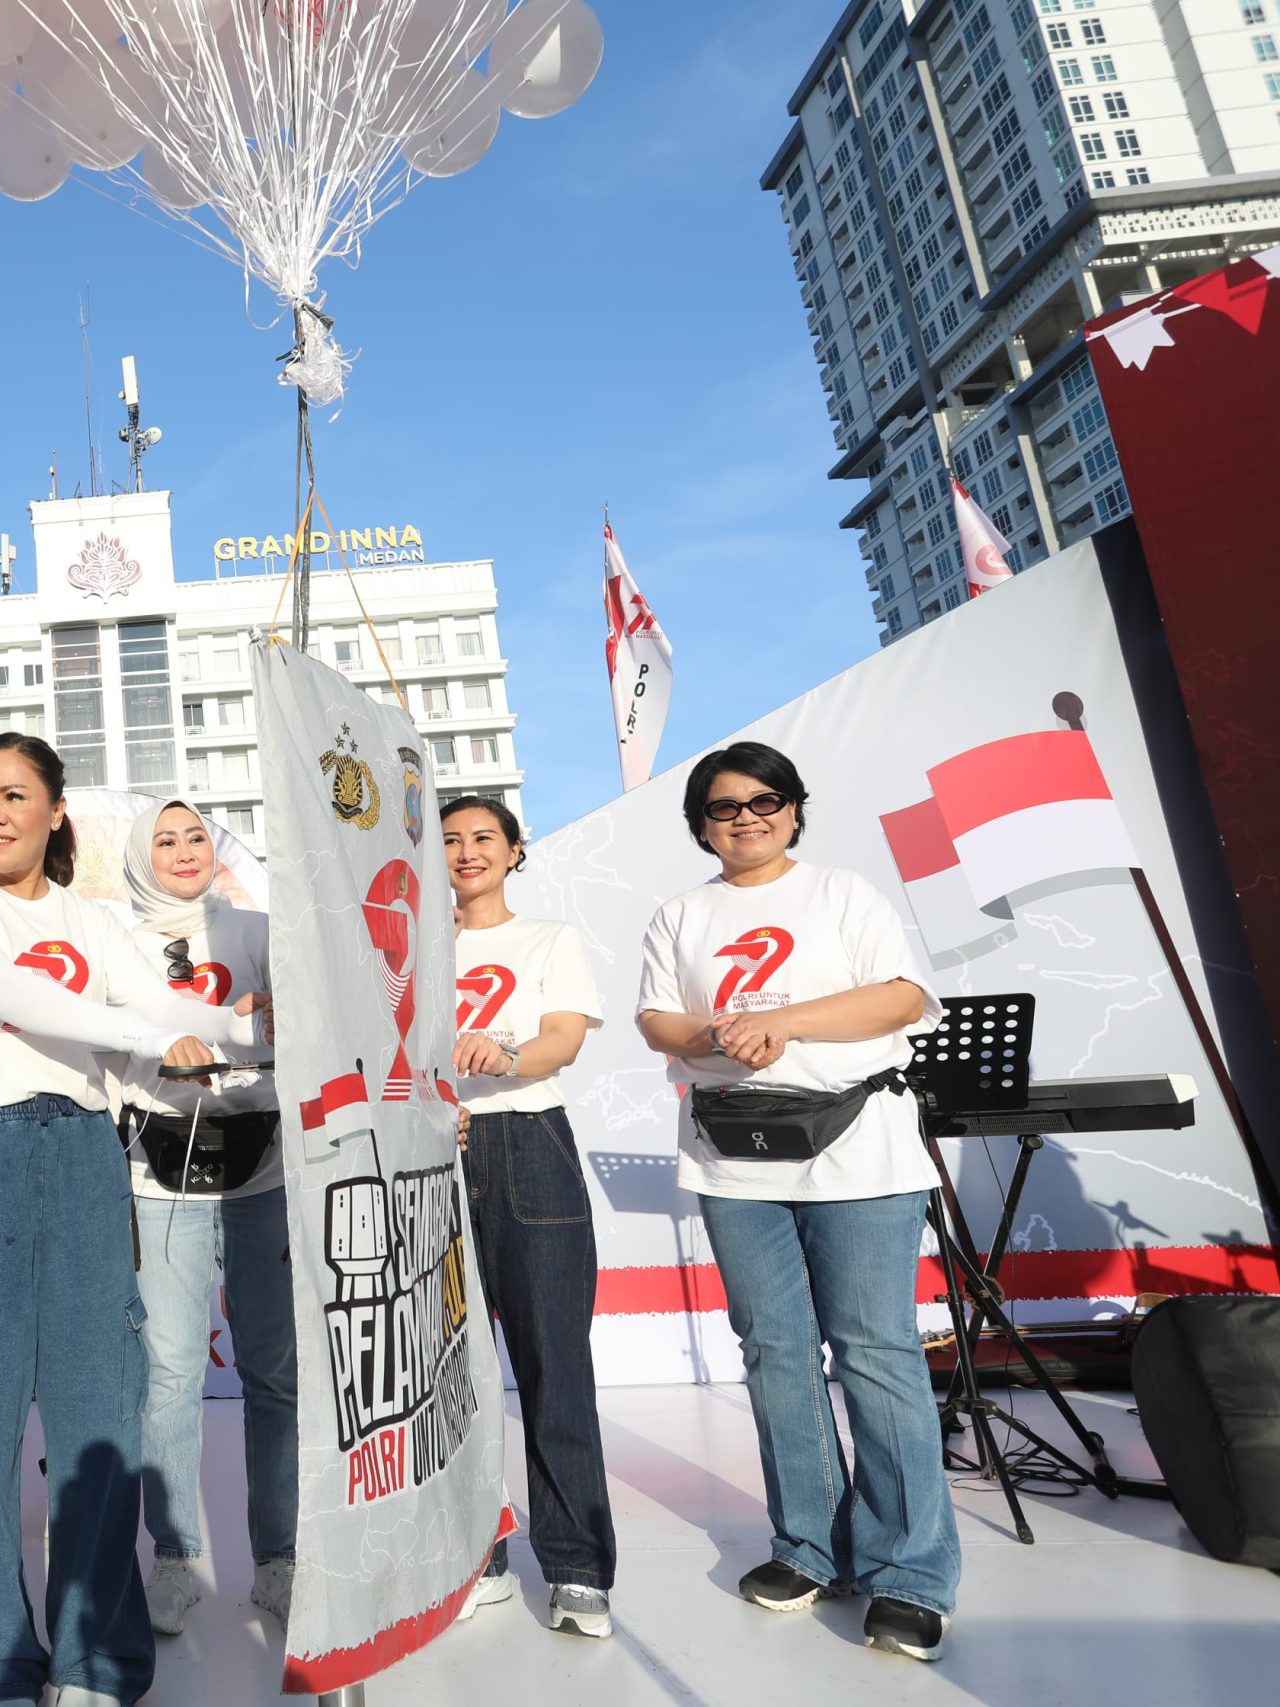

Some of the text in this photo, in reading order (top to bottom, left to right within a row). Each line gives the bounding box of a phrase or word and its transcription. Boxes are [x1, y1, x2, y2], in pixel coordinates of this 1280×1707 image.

[214, 524, 423, 560] GRAND INNA
[359, 548, 425, 566] MEDAN
[732, 991, 791, 1003] POLRI UNTUK
[732, 999, 791, 1010] MASYARAKAT
[348, 1426, 405, 1506] POLRI
